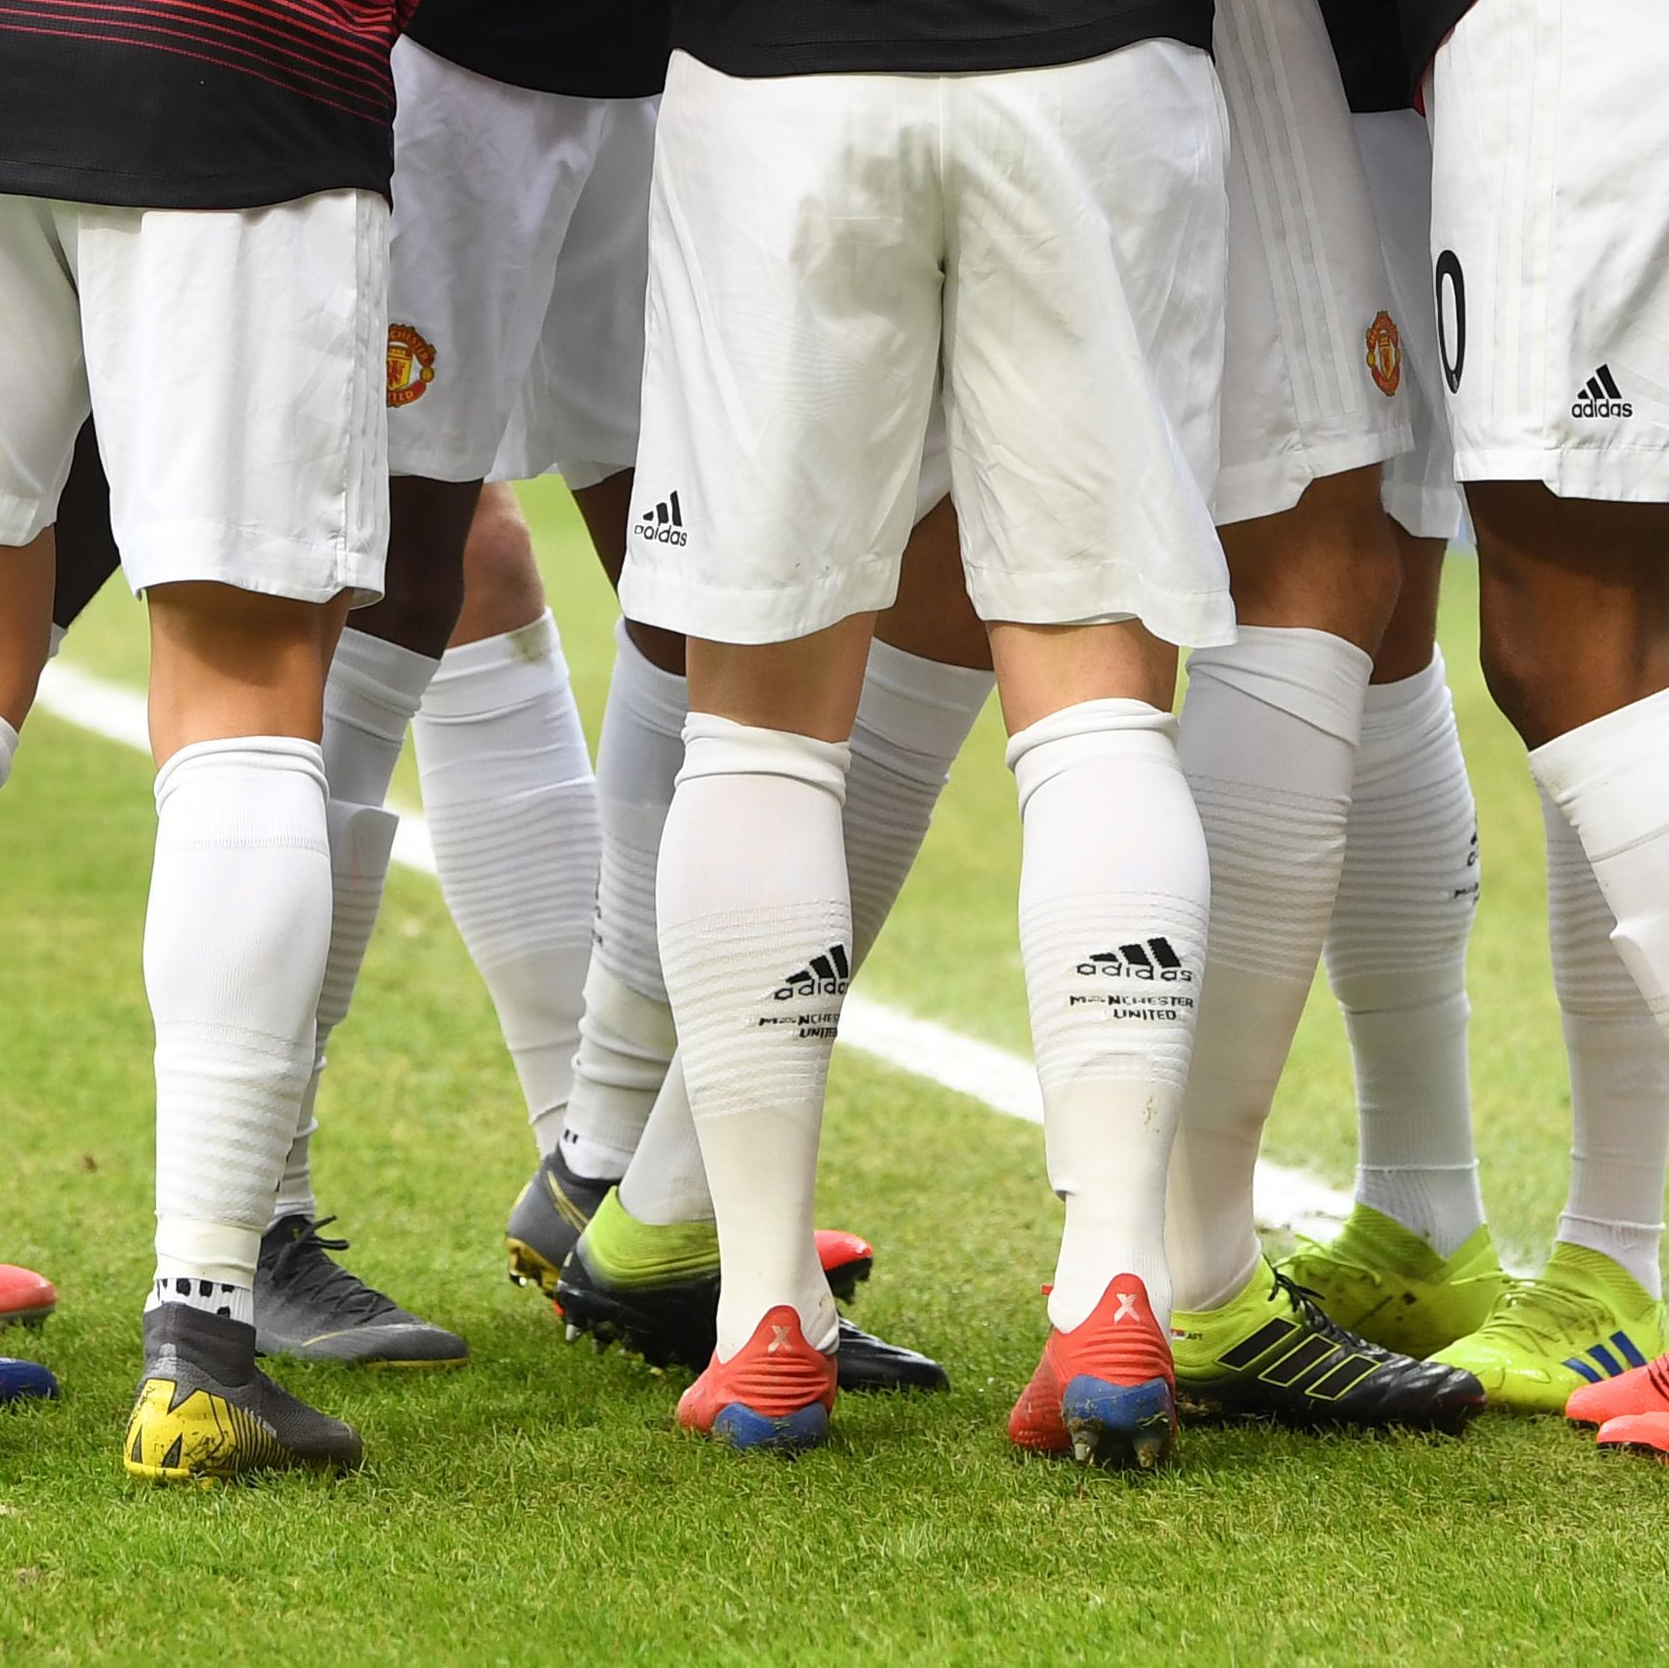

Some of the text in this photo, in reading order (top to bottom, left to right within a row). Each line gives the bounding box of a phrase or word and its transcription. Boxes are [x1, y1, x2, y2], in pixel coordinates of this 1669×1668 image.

[1571, 398, 1633, 419] adidas
[1076, 961, 1193, 982] adidas
[774, 978, 848, 1001] adida
[1113, 1008, 1177, 1021] UNITED
